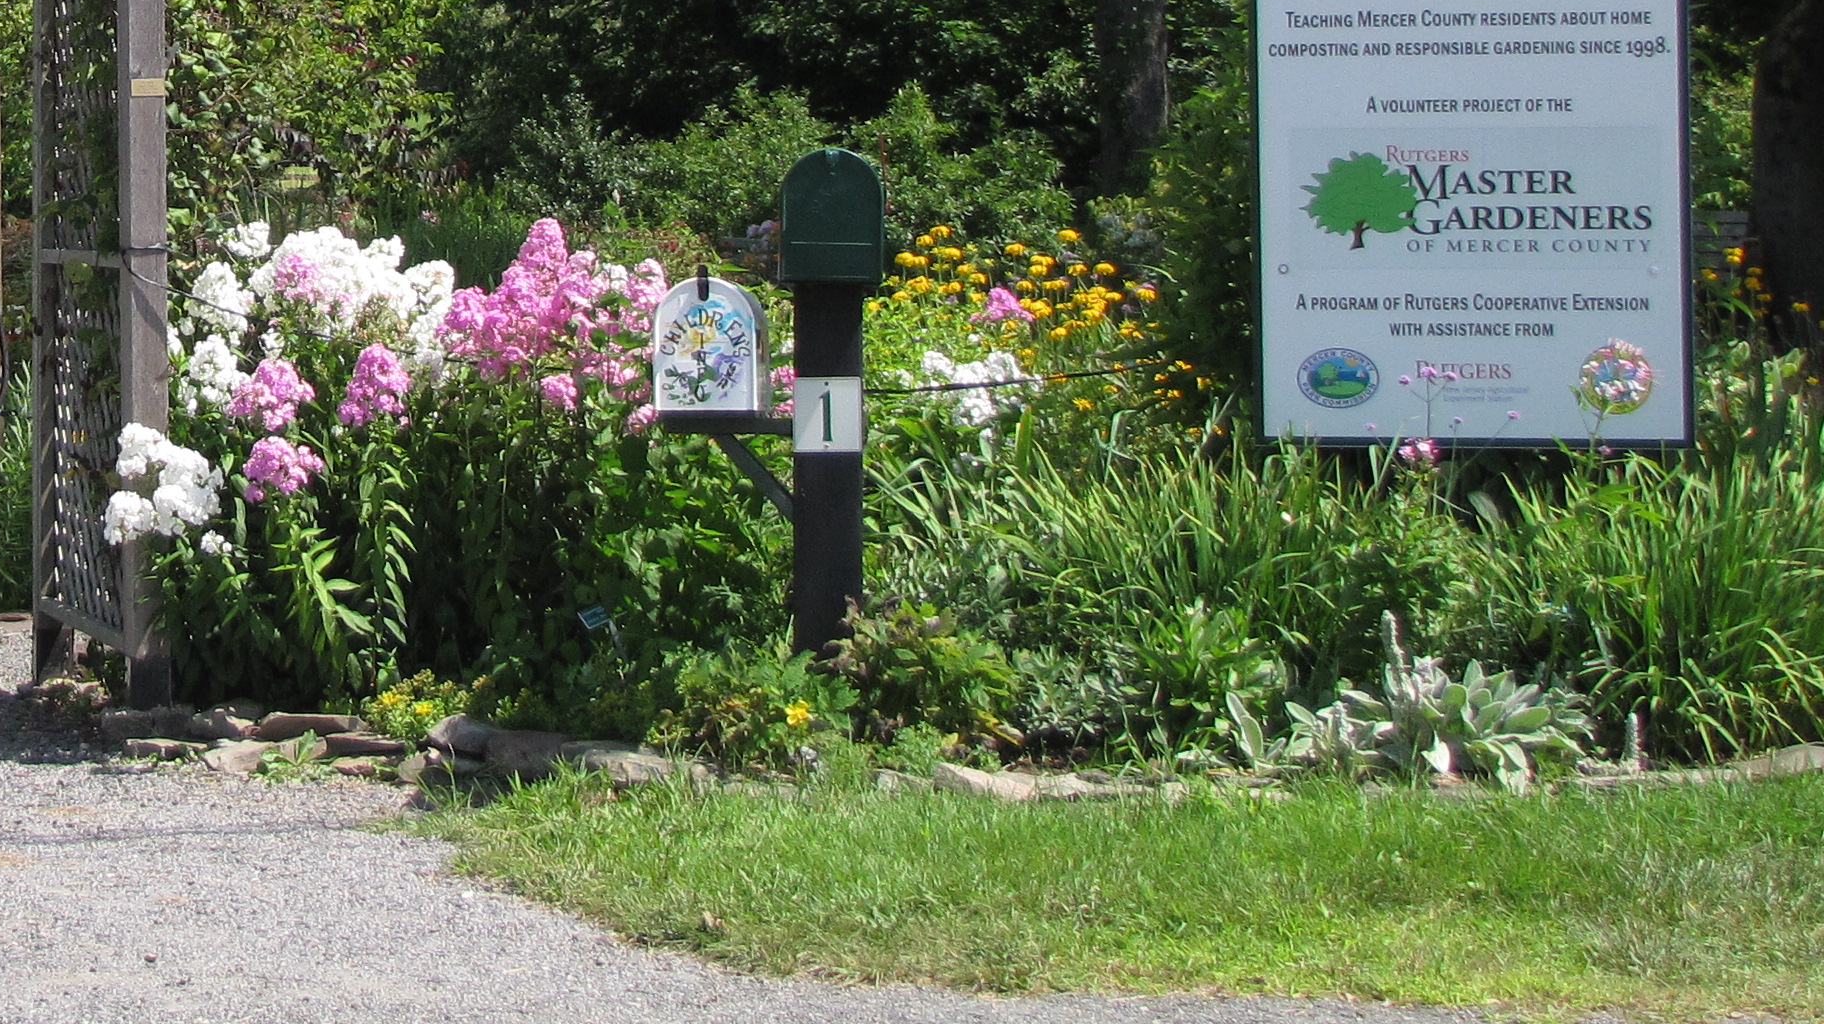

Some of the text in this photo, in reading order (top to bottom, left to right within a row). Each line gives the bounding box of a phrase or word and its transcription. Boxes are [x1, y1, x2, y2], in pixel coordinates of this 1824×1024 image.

[1285, 9, 1651, 29] TEACHING MERCER COUNTY RESIDENTS ABOUT HOME
[1268, 36, 1671, 57] COMPOSTING AND RESPONSIBLE GARDENING SINCE 1998.
[1366, 96, 1572, 113] A VOLUNTEER PROJECT OF THE
[1385, 144, 1470, 164] RUTGERS
[1405, 164, 1576, 200] MASTER
[1406, 198, 1652, 235] GARDENERS
[1406, 239, 1652, 253] OF MERCER COUNTY
[1296, 293, 1649, 311] A PROGRAM OF RUTGERS COOPERATIVE EXTENSION
[1389, 322, 1554, 337] WITH ASSISTANCE FROM
[818, 389, 834, 442] 1
